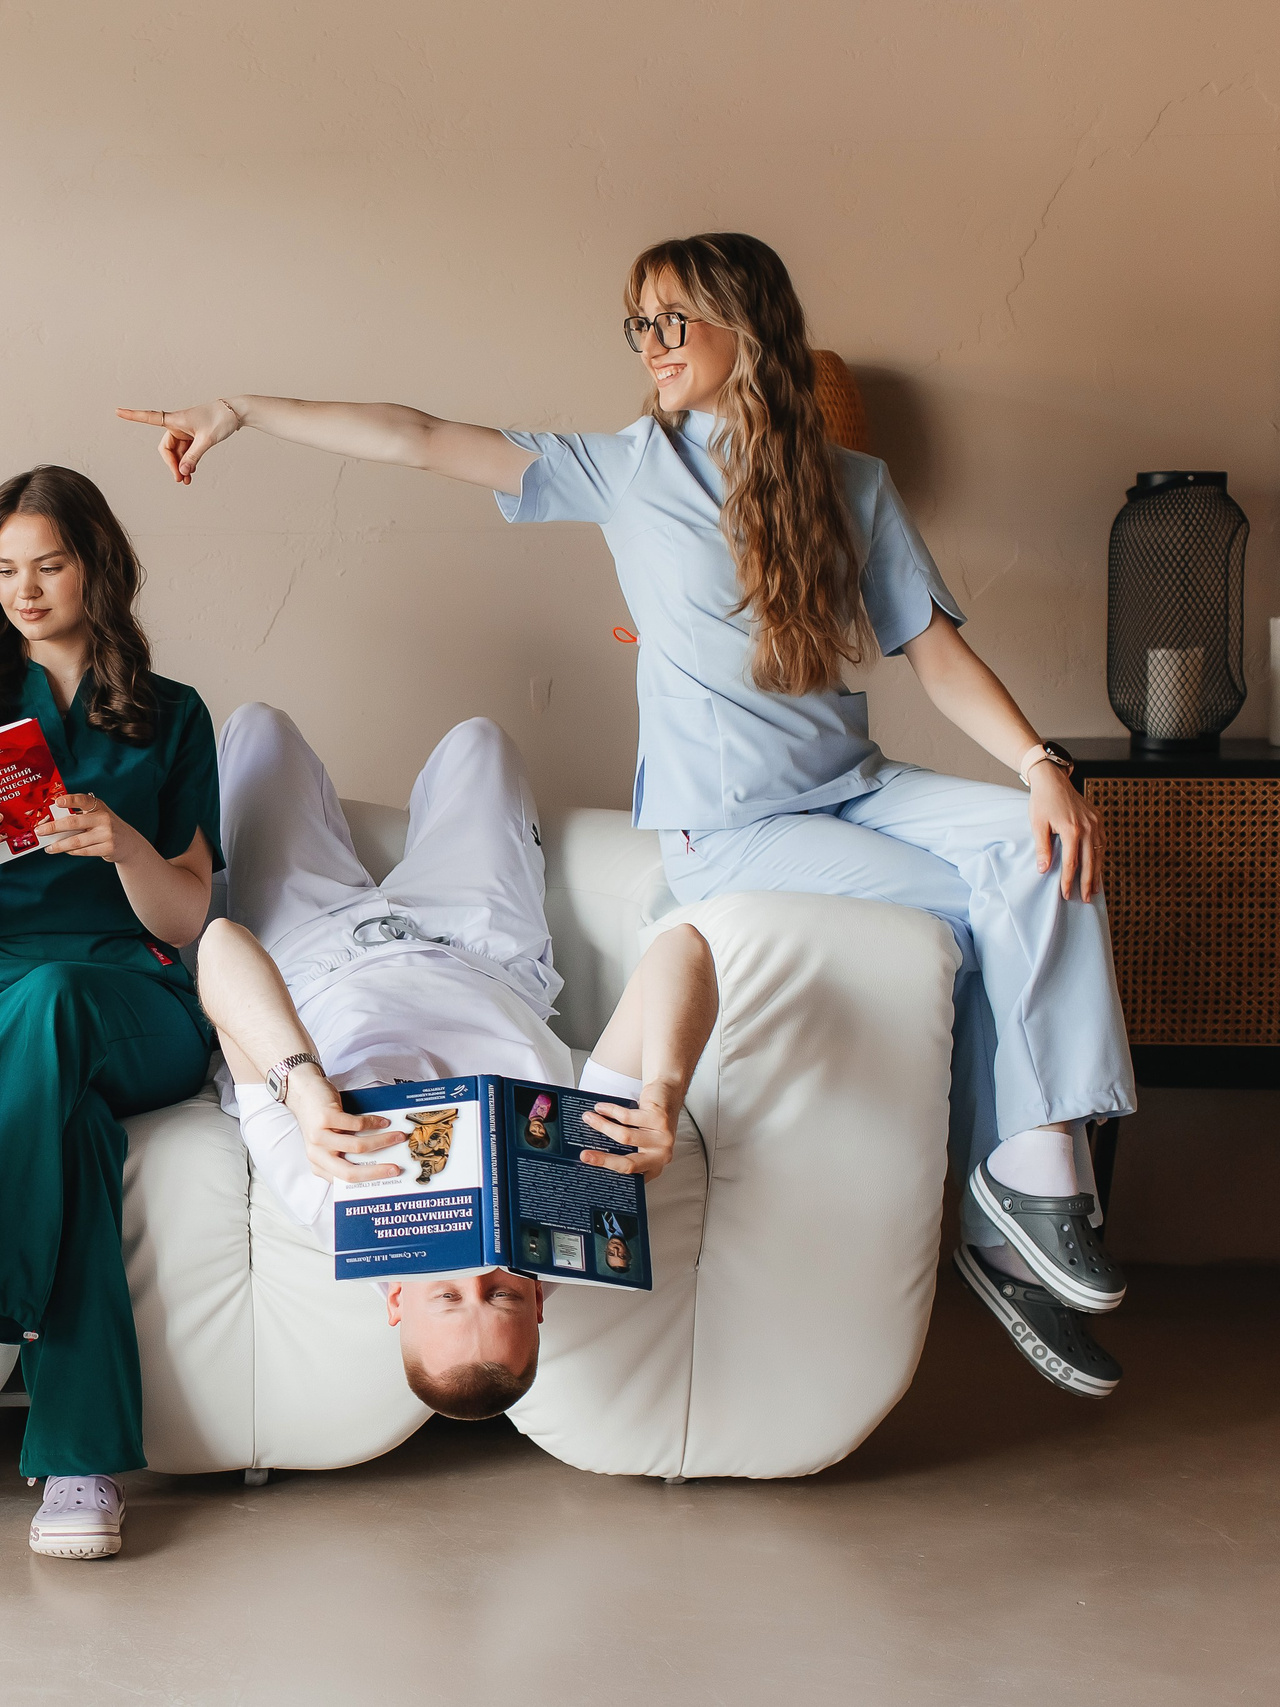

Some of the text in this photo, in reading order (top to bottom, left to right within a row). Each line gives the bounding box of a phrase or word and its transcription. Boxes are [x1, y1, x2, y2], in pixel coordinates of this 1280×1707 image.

[345, 1195, 473, 1217] ИНТЕНСИВНАЯ ТЕРАПИЯ
[371, 1208, 473, 1226] РЕАНИМАТОЛОГИЯ,
[374, 1221, 473, 1239] АНЕСТЕЗИОЛОГИЯ,
[1011, 1321, 1074, 1381] crocs
